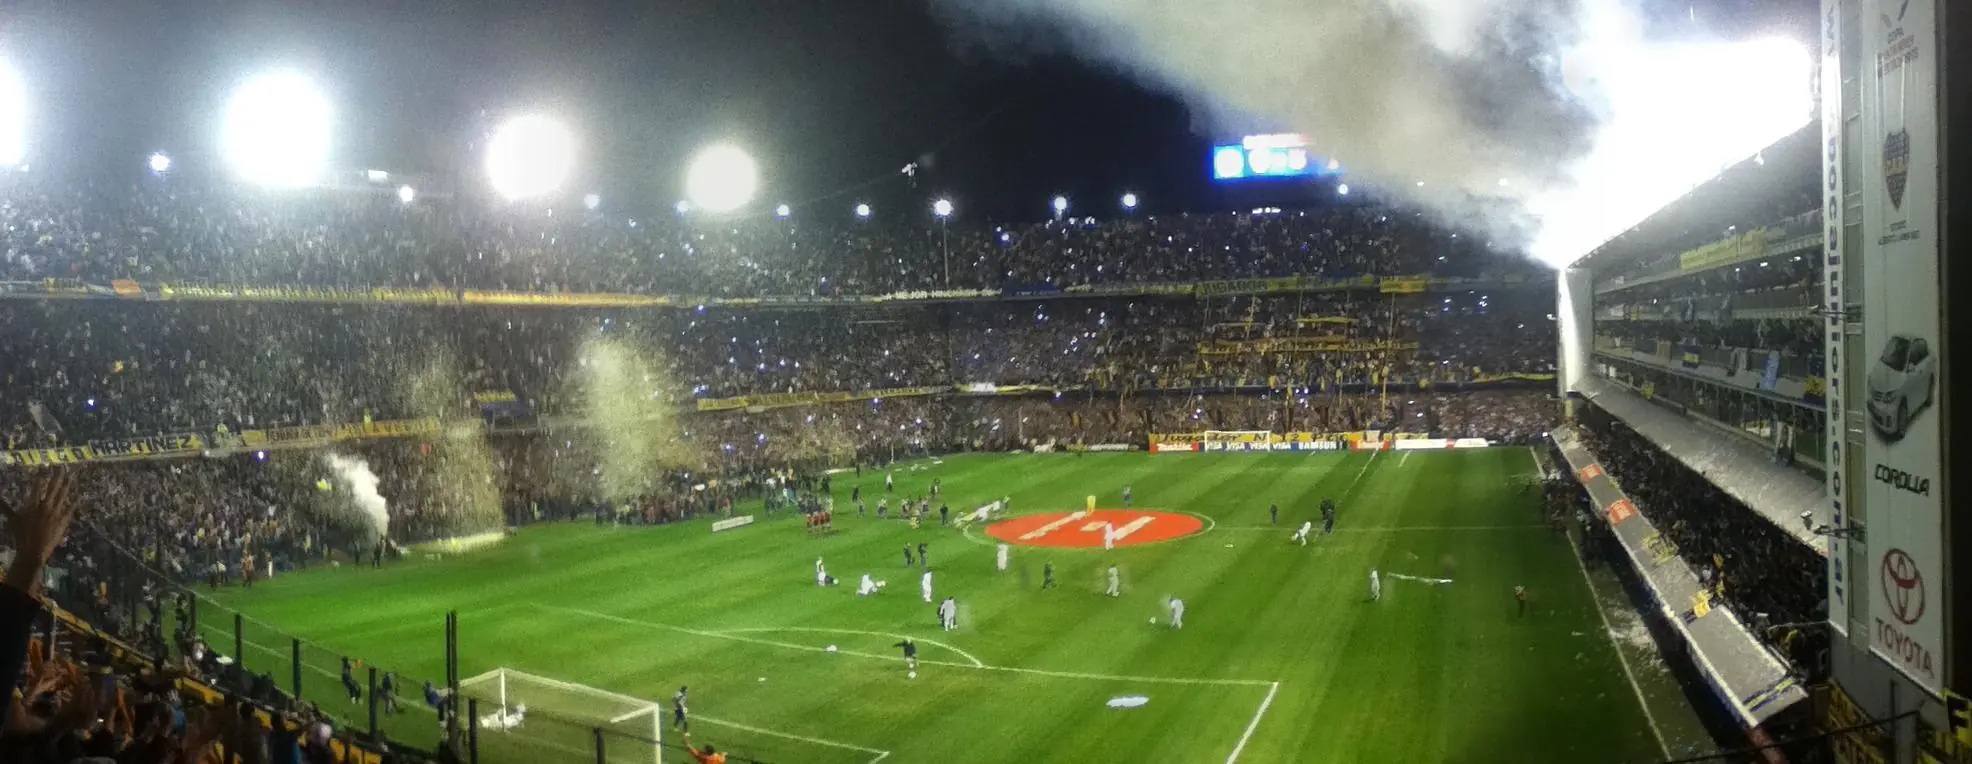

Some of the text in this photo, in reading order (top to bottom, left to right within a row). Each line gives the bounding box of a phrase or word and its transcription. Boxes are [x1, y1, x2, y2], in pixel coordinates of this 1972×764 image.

[90, 434, 192, 455] MARTINEZ
[1874, 463, 1930, 497] COROLLA
[1875, 617, 1935, 680] TOYOTA
